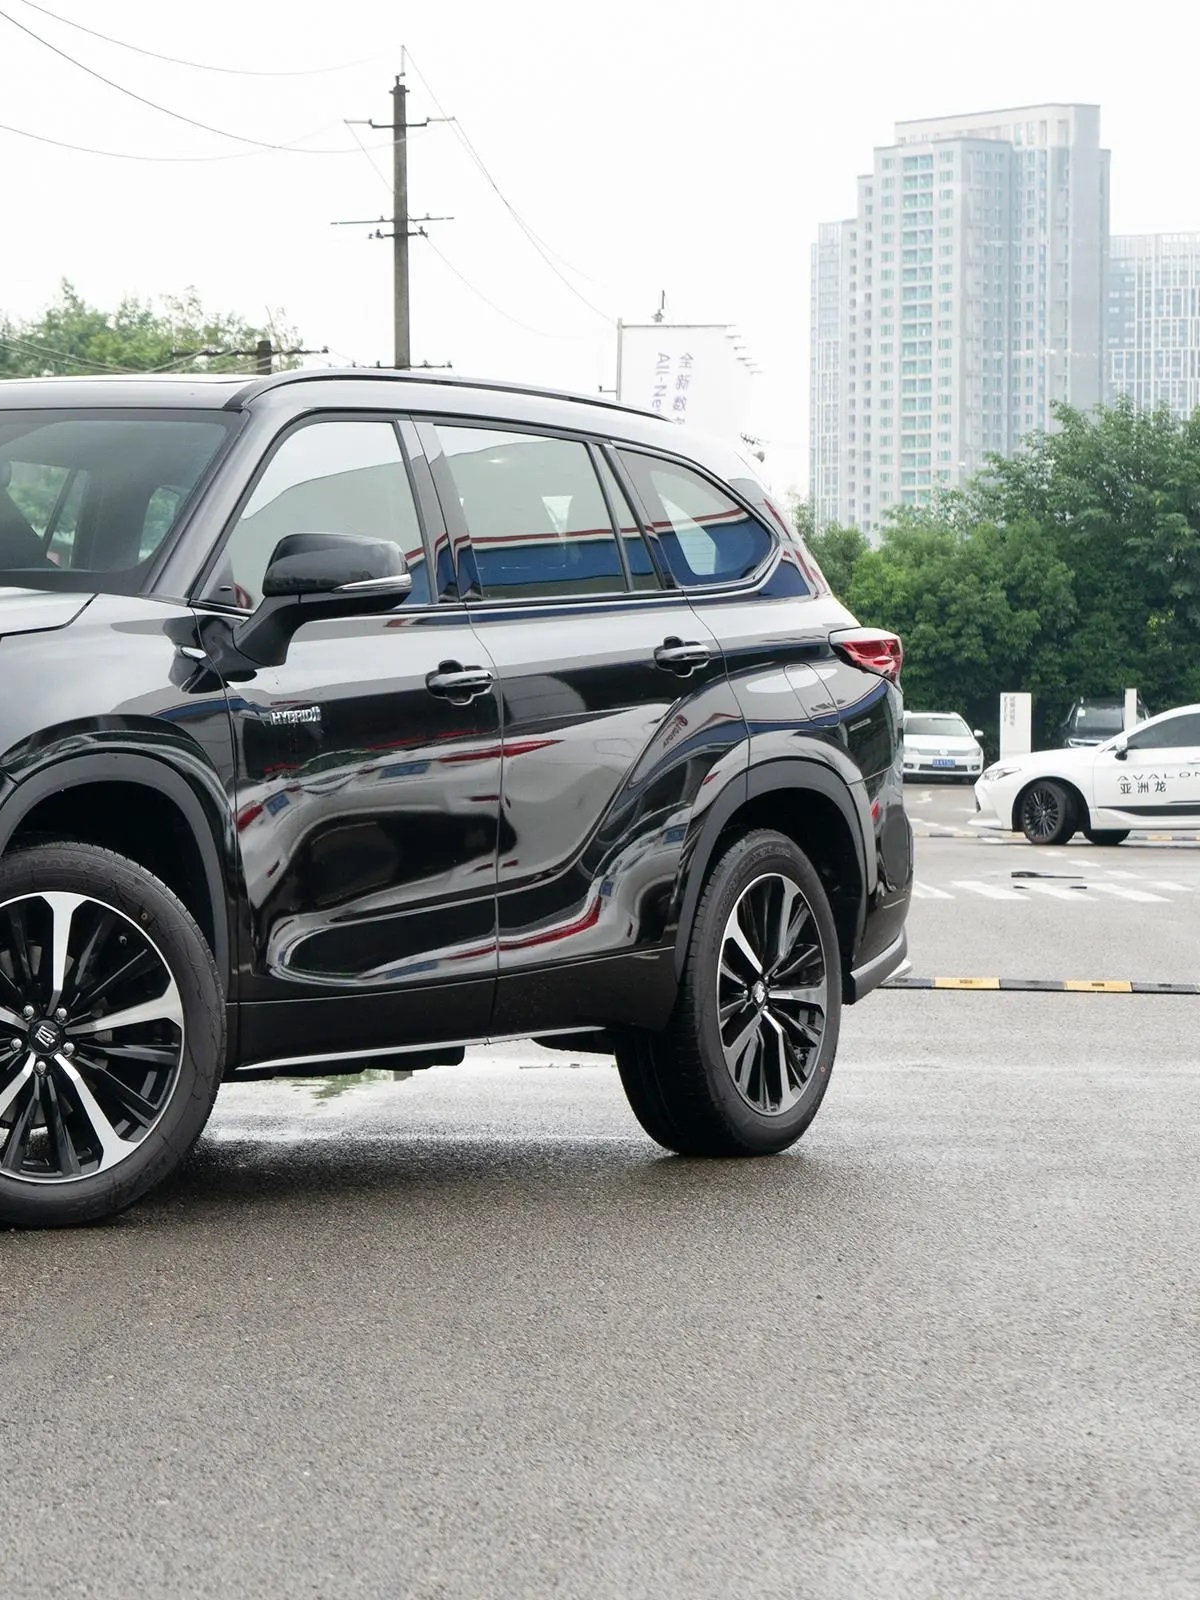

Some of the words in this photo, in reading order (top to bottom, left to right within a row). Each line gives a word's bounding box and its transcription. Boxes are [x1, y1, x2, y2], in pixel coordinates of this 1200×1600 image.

[271, 709, 313, 726] HYBRID
[1120, 780, 1166, 794] 亚洲龙
